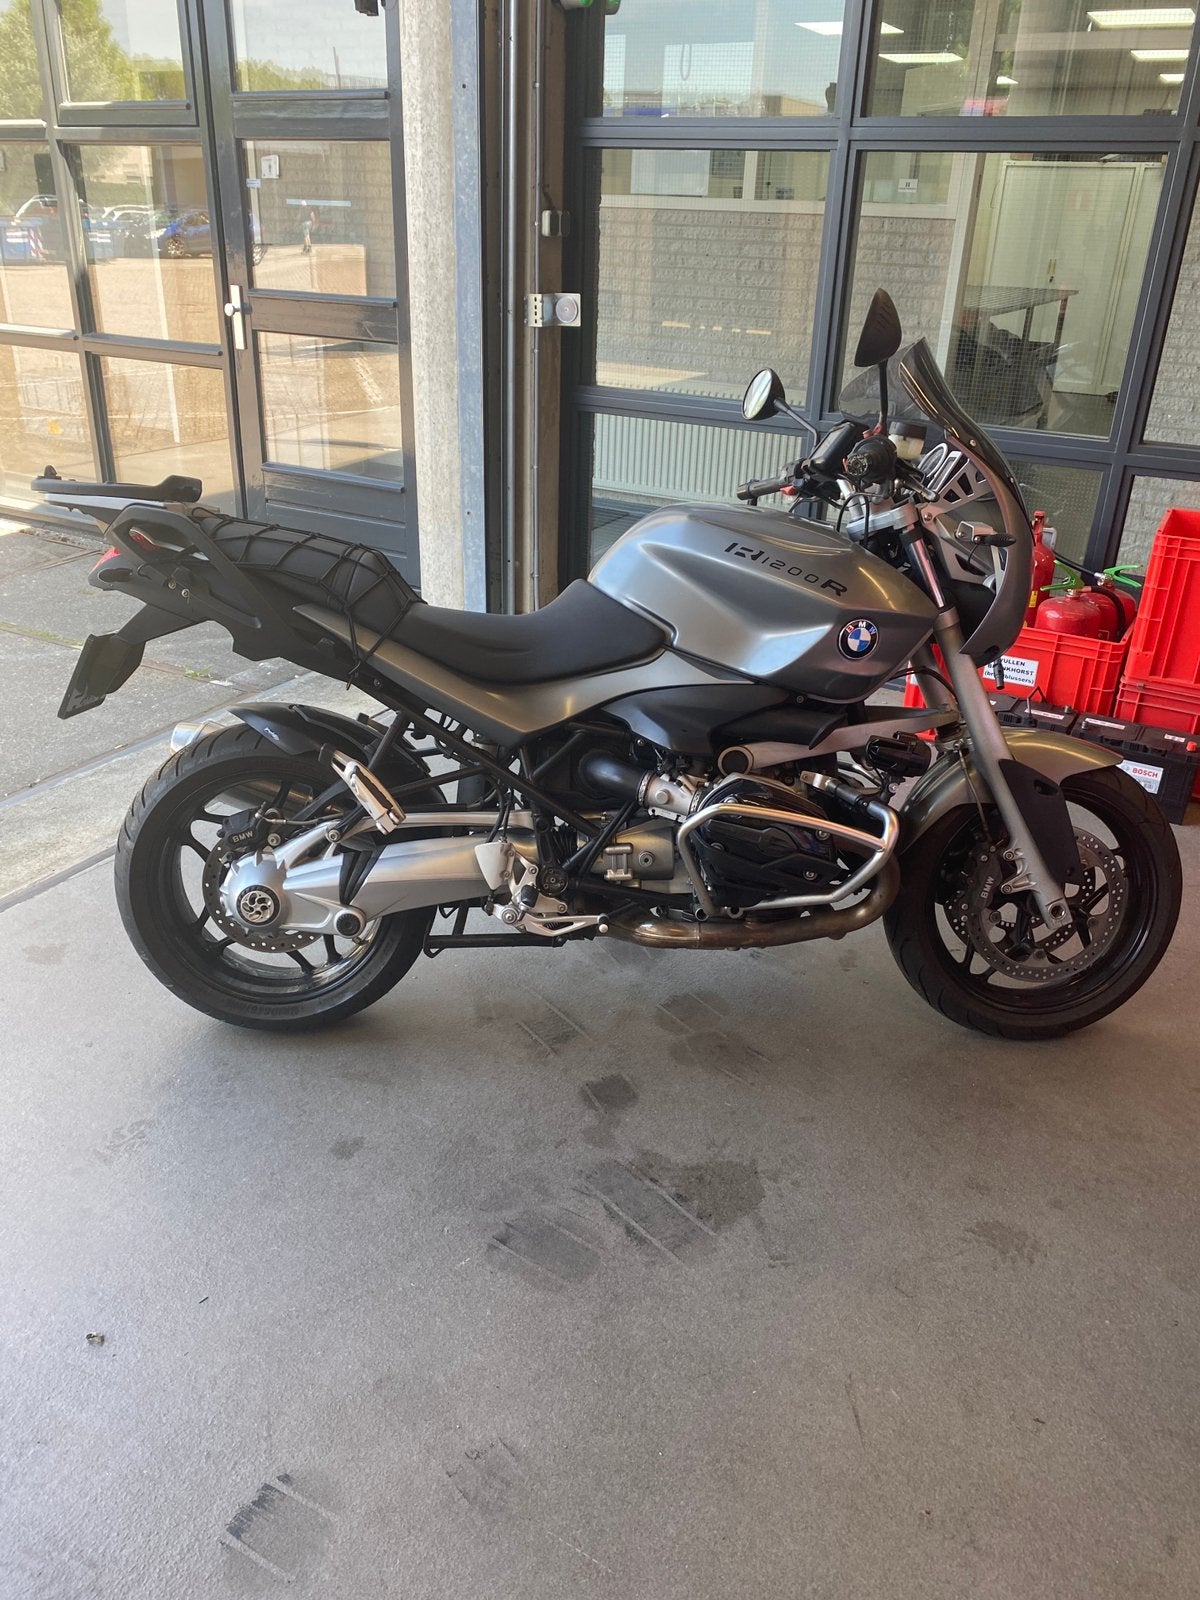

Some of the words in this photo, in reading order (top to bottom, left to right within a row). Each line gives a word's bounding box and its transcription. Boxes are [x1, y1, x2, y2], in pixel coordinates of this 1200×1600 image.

[984, 671, 1034, 685] (brblussers)
[1132, 767, 1158, 778] BOSCH
[232, 830, 253, 843] BMW
[980, 876, 994, 899] BMW
